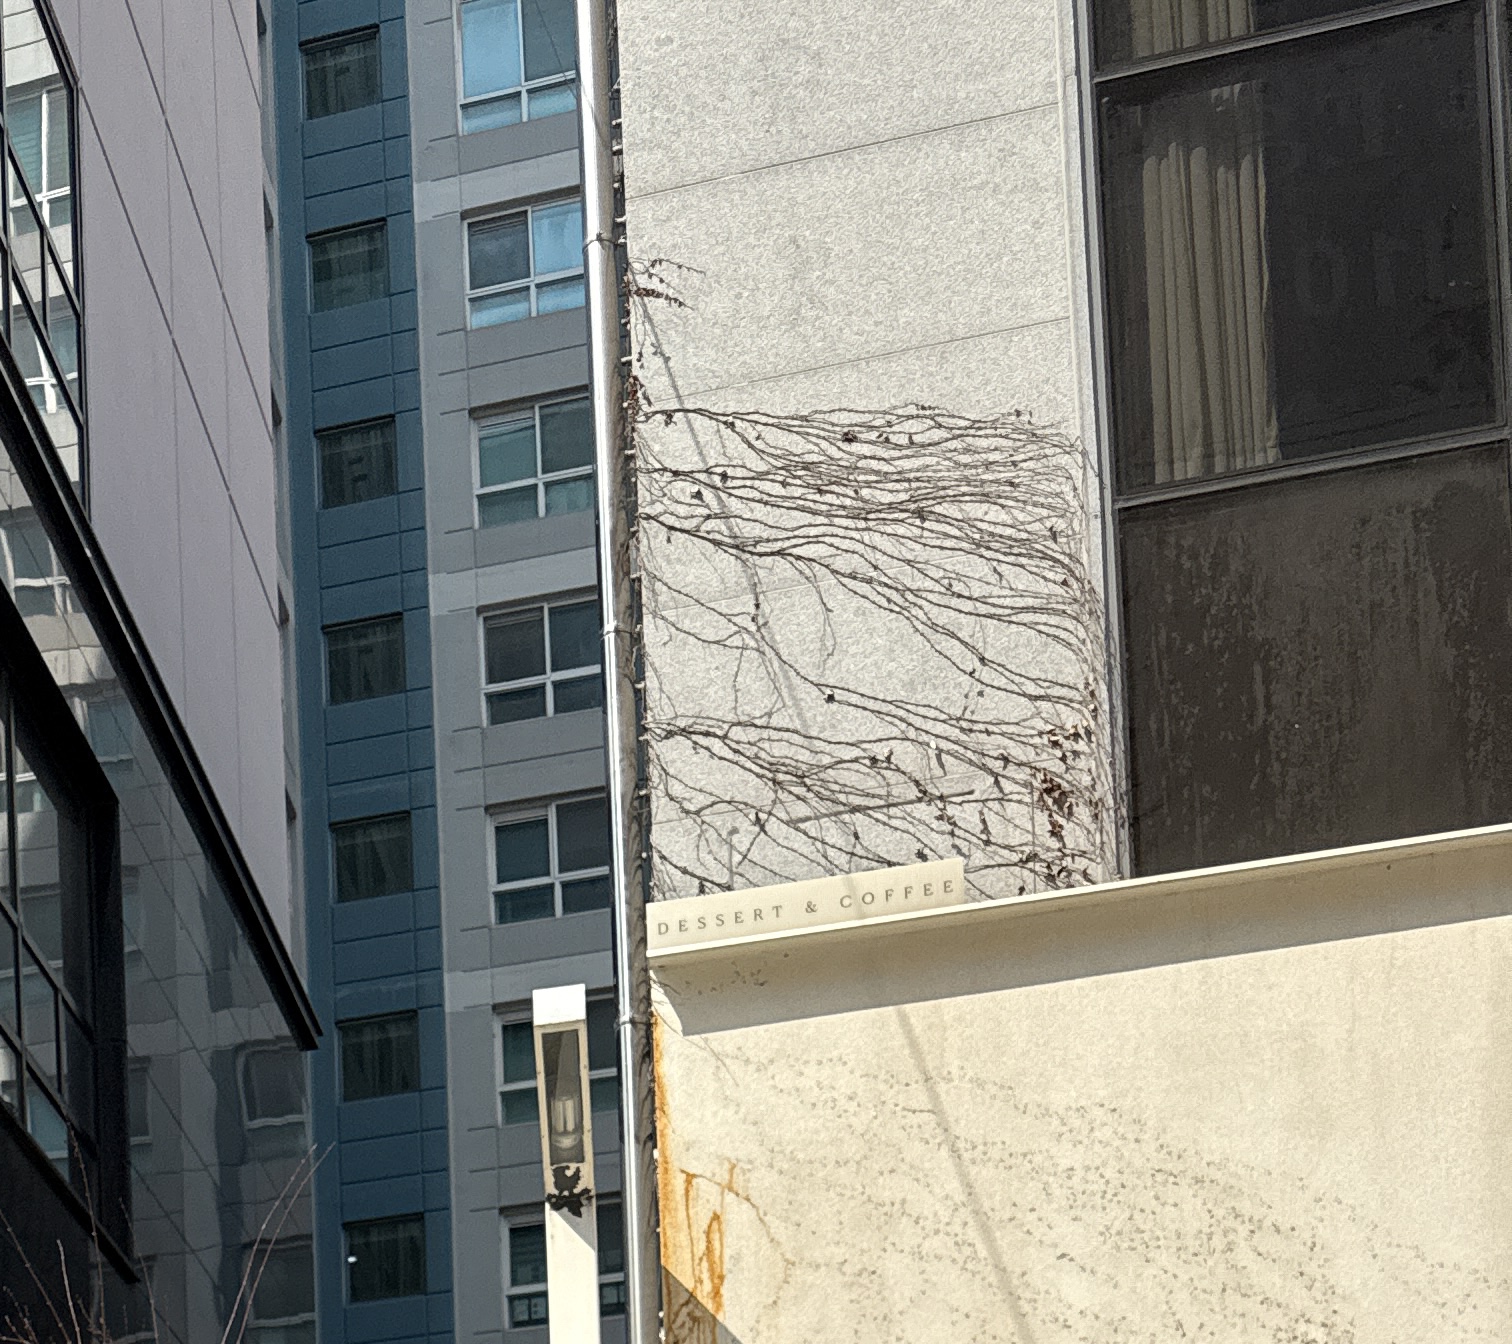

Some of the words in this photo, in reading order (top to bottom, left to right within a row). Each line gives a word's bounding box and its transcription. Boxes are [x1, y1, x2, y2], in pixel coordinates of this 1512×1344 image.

[657, 905, 783, 936] DESSERT
[805, 900, 818, 914] &
[839, 880, 955, 909] COFFEE
